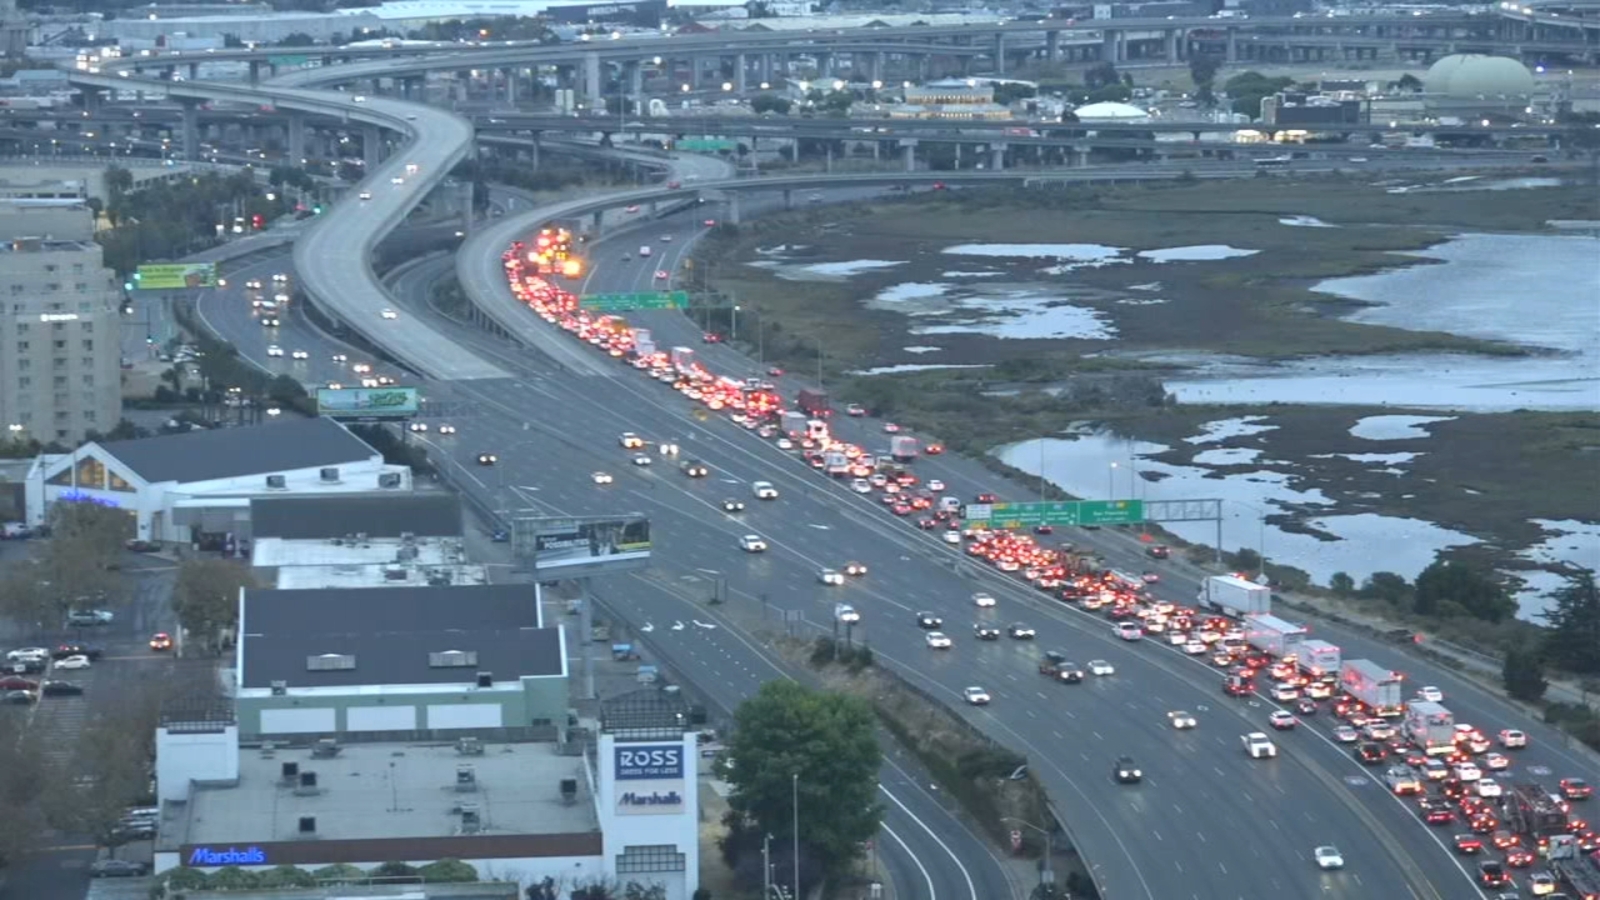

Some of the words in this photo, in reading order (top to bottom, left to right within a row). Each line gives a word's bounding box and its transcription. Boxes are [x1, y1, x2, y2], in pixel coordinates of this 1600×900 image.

[620, 750, 678, 767] ROSS
[618, 791, 682, 806] Marshalls
[188, 847, 265, 866] Marshalls
